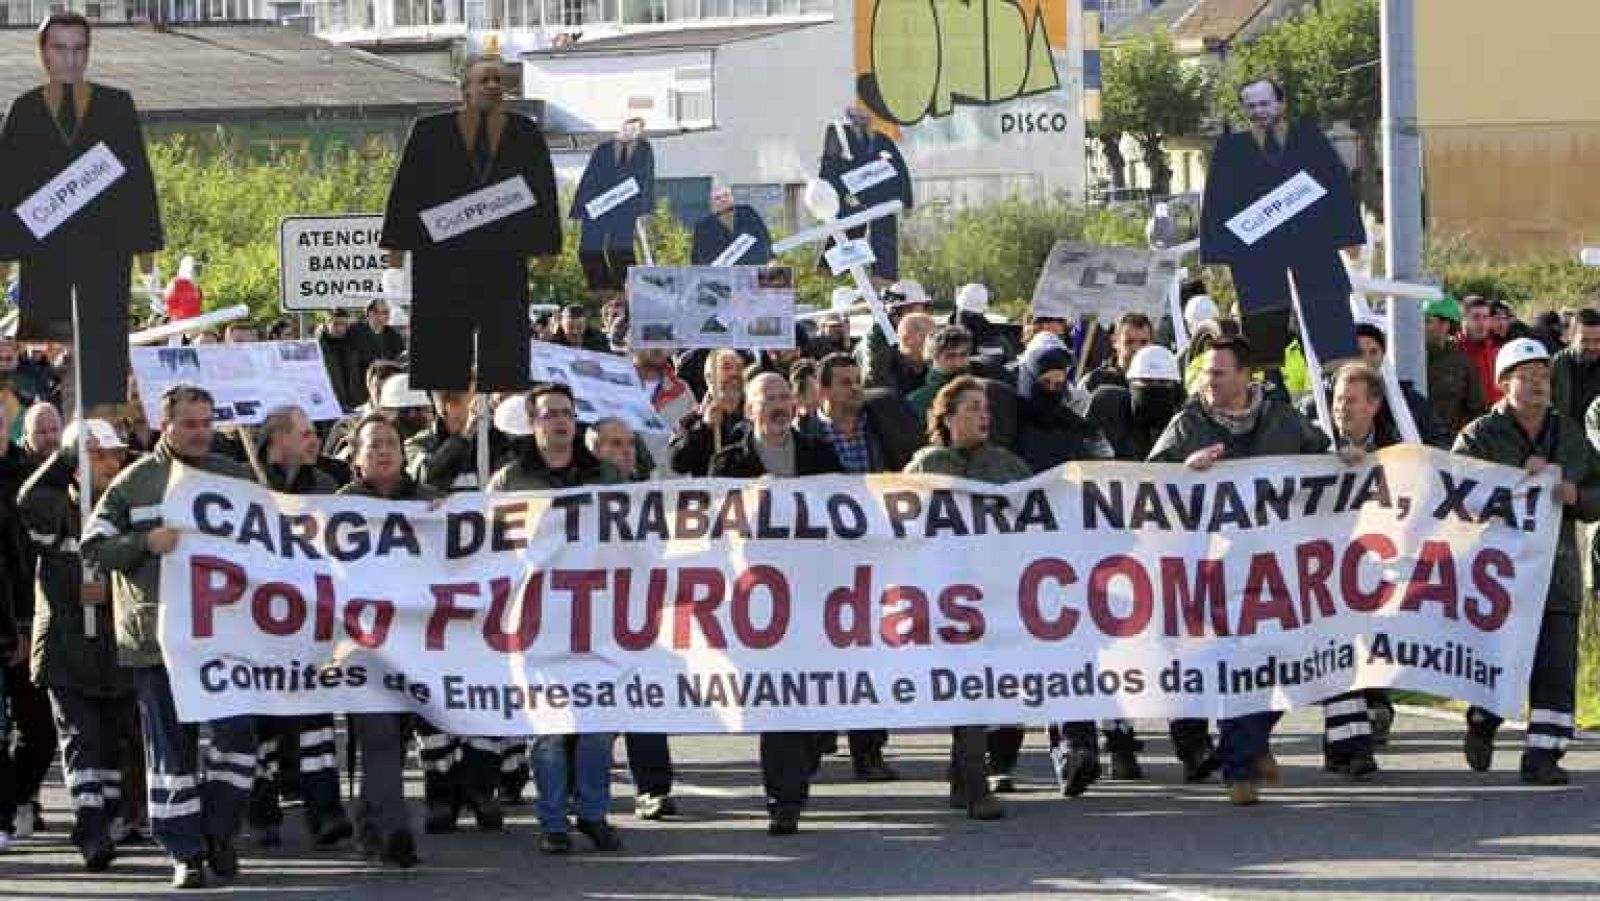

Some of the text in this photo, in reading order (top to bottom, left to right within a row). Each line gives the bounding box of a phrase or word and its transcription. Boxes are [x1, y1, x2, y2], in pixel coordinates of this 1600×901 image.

[1001, 112, 1068, 134] DISCO
[299, 229, 382, 248] ATENCI
[191, 466, 1541, 561] CARGA DE TRABALLO PARA NAVANTIA, XA!
[189, 534, 1515, 654] Polo FUTURO das COMARCAS
[443, 674, 617, 718] Empresa
[625, 674, 665, 708] de
[676, 670, 878, 708] NAVANTIA
[893, 679, 915, 703] e
[930, 663, 1145, 707] Delegados
[1158, 659, 1206, 694] da
[1216, 642, 1355, 694] Industria
[1367, 633, 1503, 691] Auxiliar
